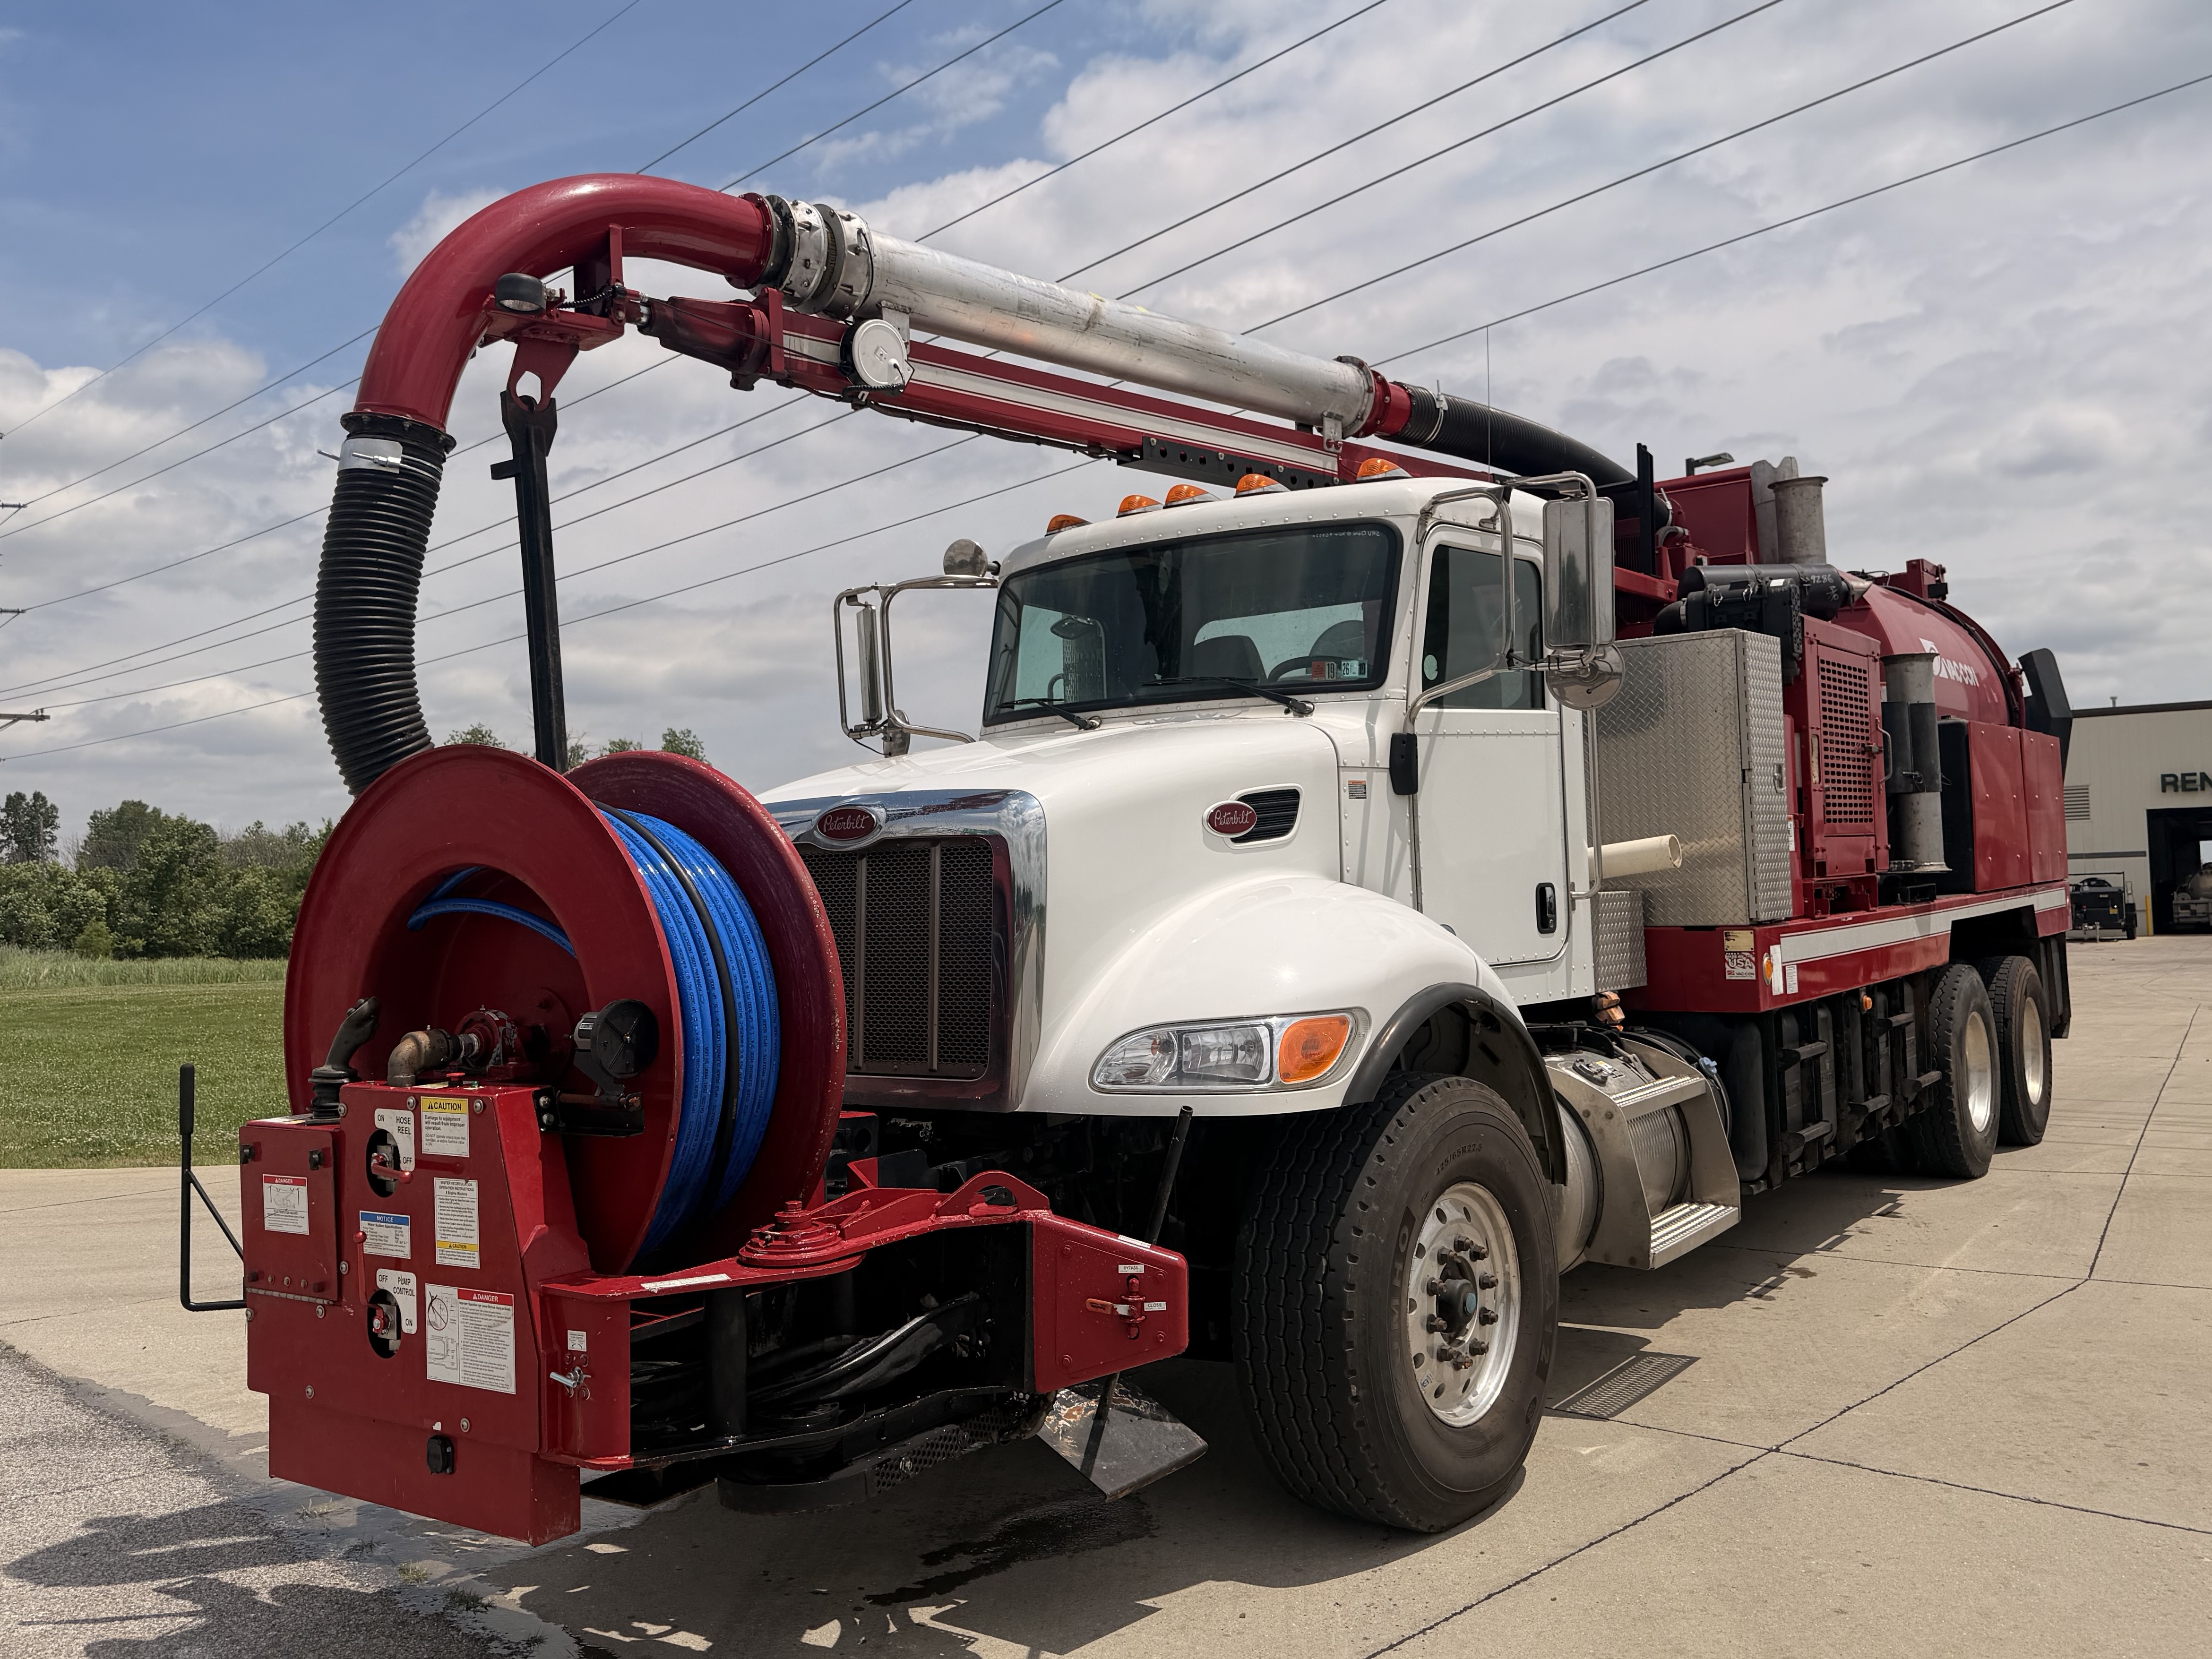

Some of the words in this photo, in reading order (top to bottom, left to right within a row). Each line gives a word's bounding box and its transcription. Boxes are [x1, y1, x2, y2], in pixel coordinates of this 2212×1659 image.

[1327, 663, 1334, 679] 19
[1343, 662, 1349, 675] 26
[1214, 810, 1252, 827] Peterbilt
[824, 815, 869, 833] Peterbilt
[1729, 958, 1753, 968] USA
[434, 1102, 462, 1110] CAUTION
[378, 1114, 385, 1122] ON
[396, 1116, 411, 1125] HOSE
[397, 1126, 412, 1135] REEL
[379, 1274, 388, 1283] OFF
[393, 1287, 415, 1297] CONTROL
[477, 1294, 498, 1302] DANGER
[405, 1318, 413, 1326] ON
